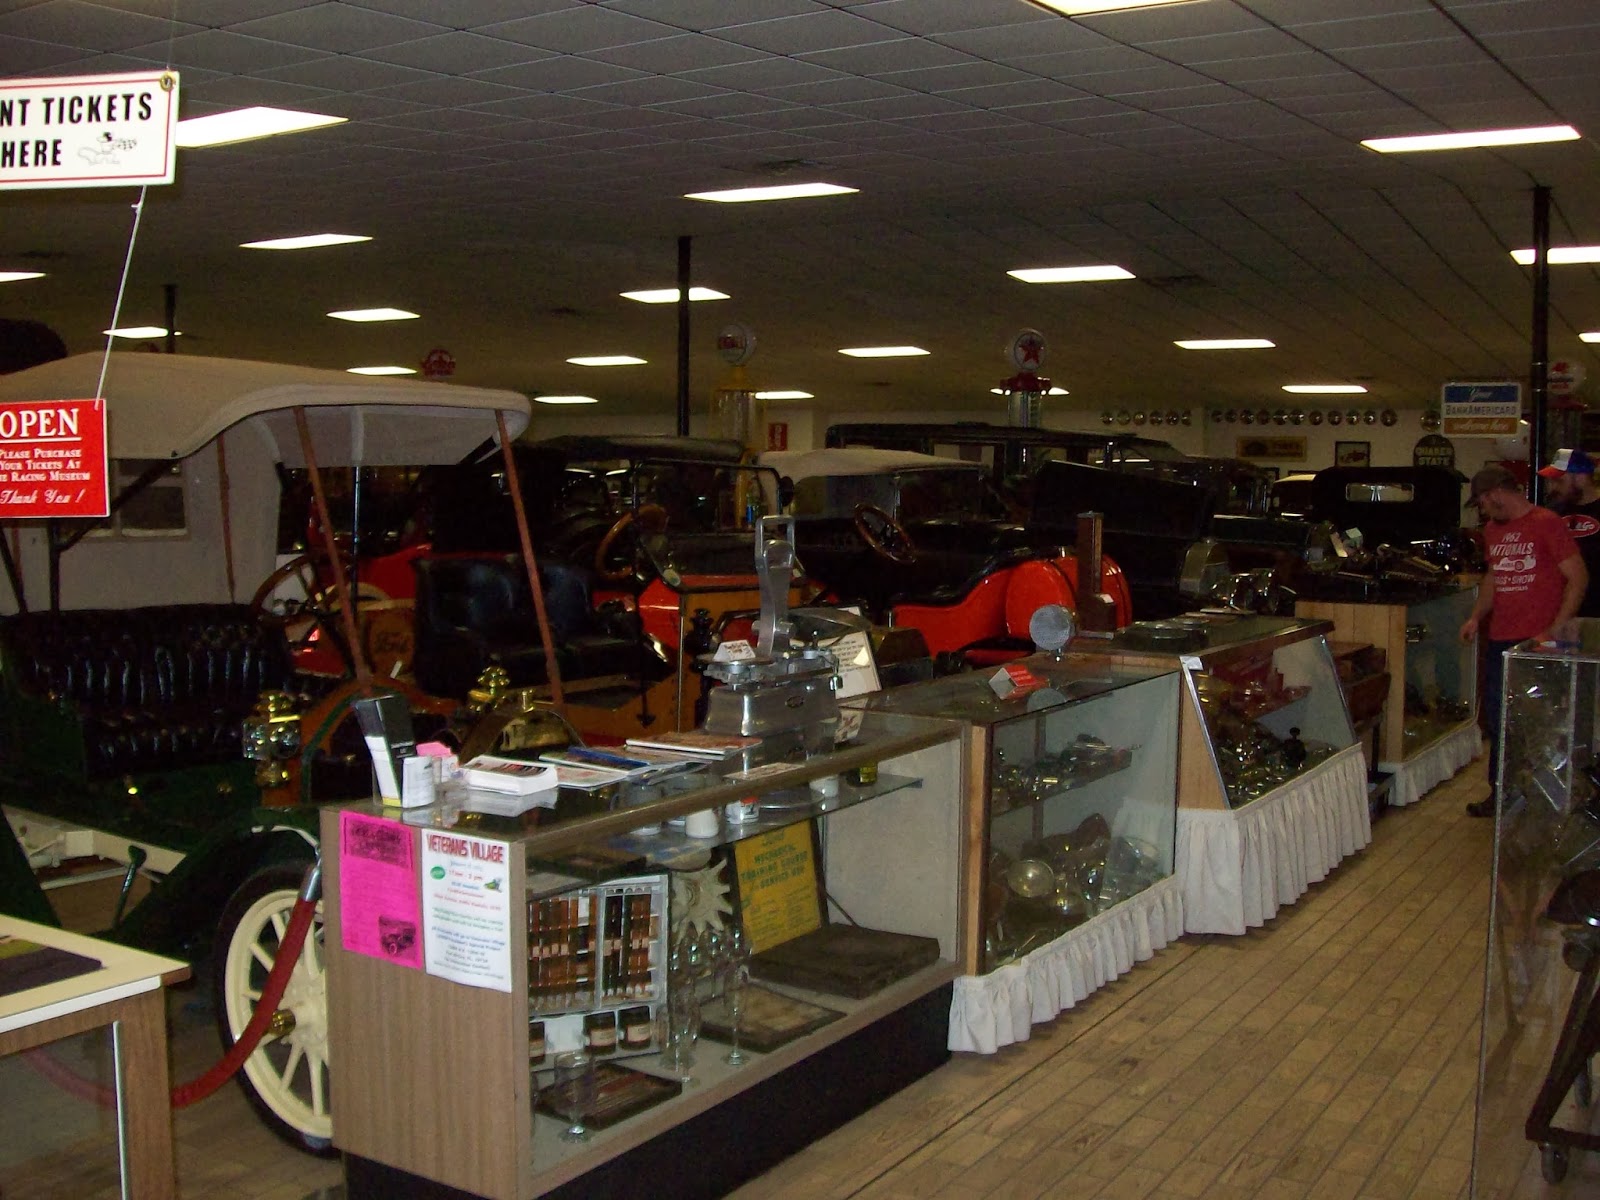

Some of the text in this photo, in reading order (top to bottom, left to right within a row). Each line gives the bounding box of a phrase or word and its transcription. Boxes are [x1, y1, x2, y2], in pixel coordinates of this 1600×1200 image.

[42, 92, 153, 125] TICKETS
[1, 139, 62, 168] HERE
[0, 408, 79, 438] OPEN
[426, 833, 468, 857] VETERANS
[469, 841, 504, 864] VILLAGE
